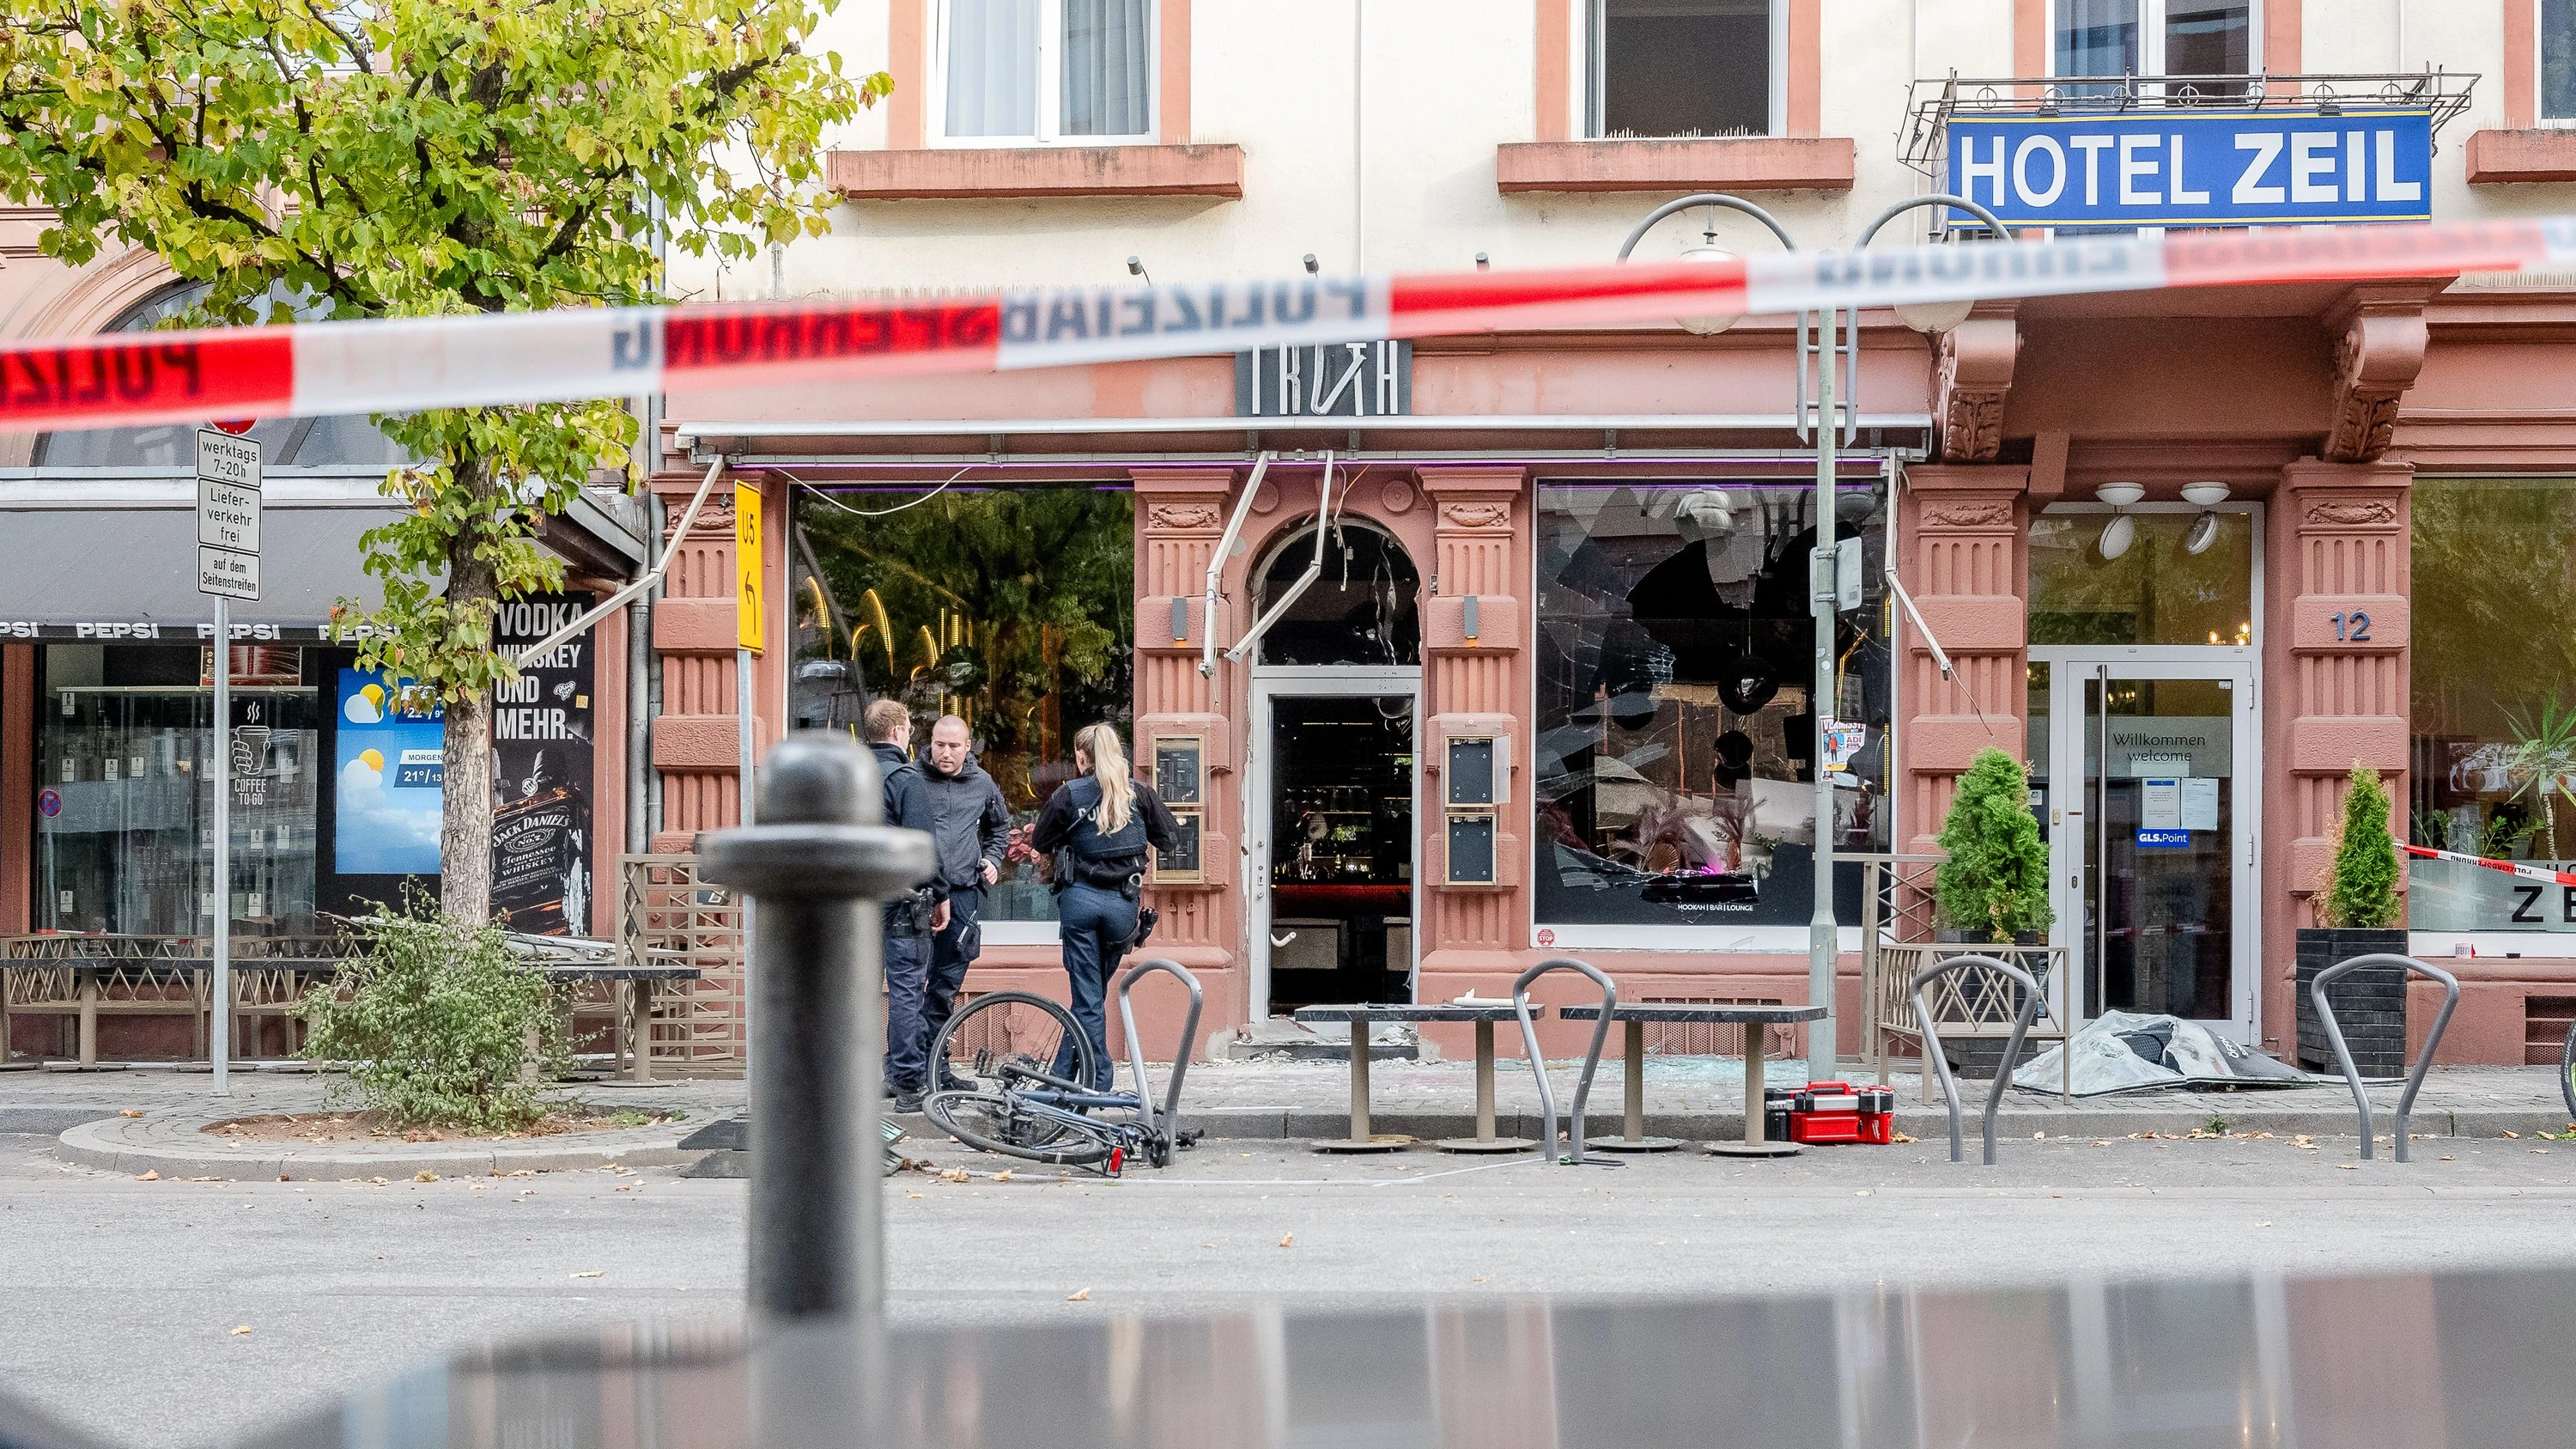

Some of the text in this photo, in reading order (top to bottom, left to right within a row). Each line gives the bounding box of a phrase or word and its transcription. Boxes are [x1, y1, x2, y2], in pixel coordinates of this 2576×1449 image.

[1960, 131, 2421, 207] HOTEL ZEIL
[203, 441, 258, 464] werktags
[210, 487, 250, 508] Liefer-
[207, 508, 252, 527] verkehr
[742, 509, 755, 545] U5
[221, 527, 240, 543] frei
[213, 558, 246, 574] auf dem
[203, 571, 256, 593] Seitenstreifen
[498, 603, 586, 636] VODKA
[2330, 611, 2371, 641] 12
[76, 622, 160, 638] PEPSI
[197, 623, 281, 640] PPSI
[496, 676, 540, 703] UND
[495, 709, 574, 740] MEHR.
[2112, 733, 2206, 746] Willkommen
[2127, 749, 2192, 762] welcome
[234, 778, 266, 793] COFFEE
[239, 793, 263, 806] TO GO
[493, 824, 522, 847] JACK
[2139, 833, 2187, 843] GLS.Point
[502, 846, 556, 866] Tennessee
[502, 856, 556, 876] WHISKEY
